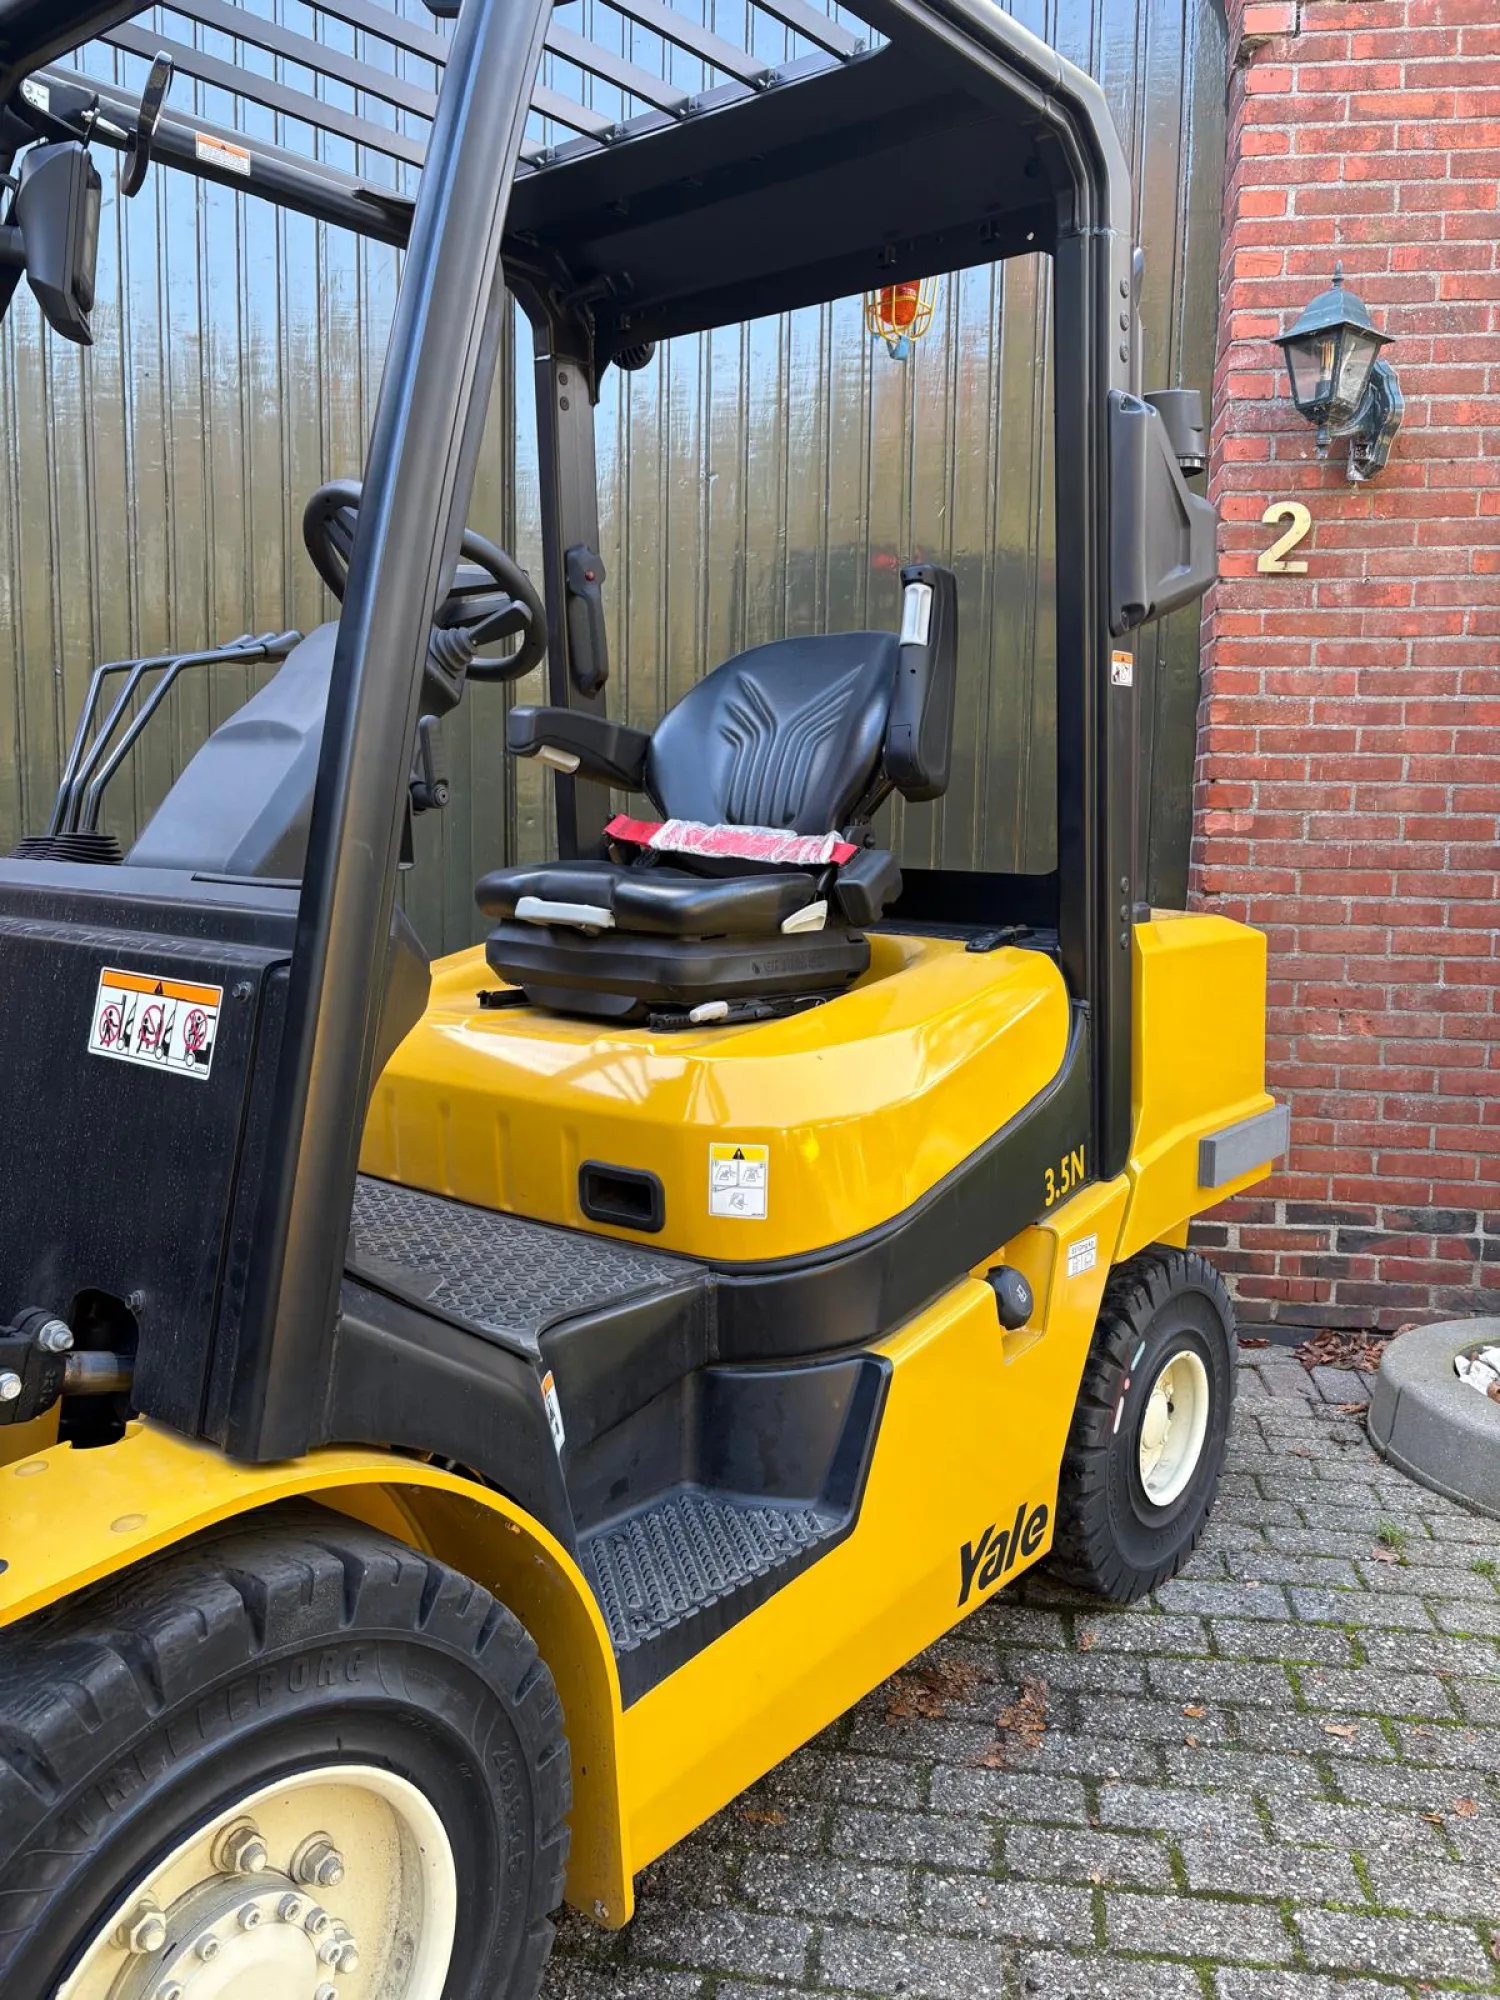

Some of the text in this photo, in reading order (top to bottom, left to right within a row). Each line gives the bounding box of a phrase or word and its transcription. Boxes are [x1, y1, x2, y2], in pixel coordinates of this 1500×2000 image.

[1257, 501, 1311, 573] 2
[1044, 1144, 1085, 1206] 3.5N
[957, 1501, 1048, 1608] Yale
